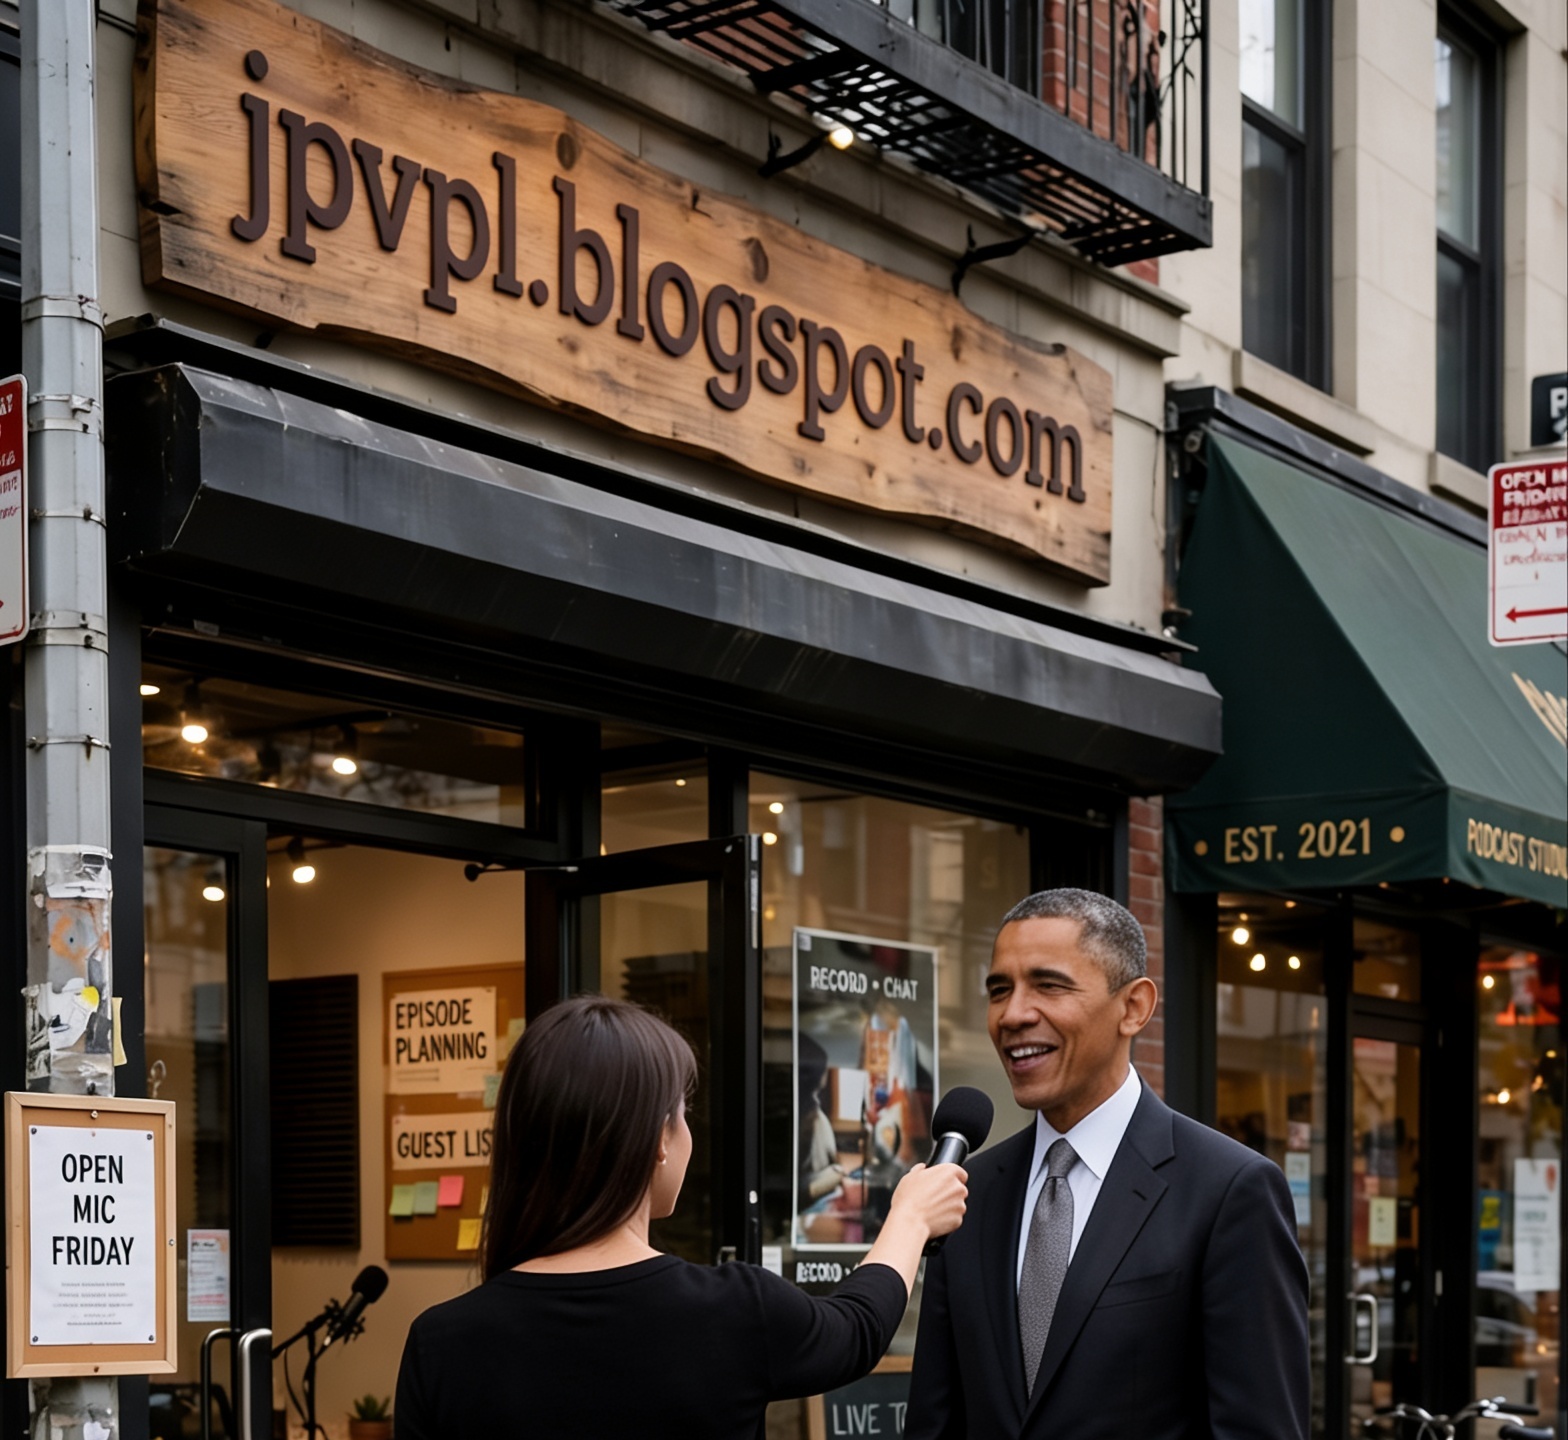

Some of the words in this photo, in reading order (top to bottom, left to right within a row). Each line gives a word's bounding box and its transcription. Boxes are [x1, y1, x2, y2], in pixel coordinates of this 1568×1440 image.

[230, 49, 1087, 503] jpvpl.blogspot.com
[1225, 825, 1285, 864] EST.
[1297, 817, 1371, 859] 2021
[1467, 817, 1526, 867] PODCAST
[810, 965, 868, 994] RECORD
[883, 976, 918, 1001] CHAT
[396, 998, 473, 1030] EPISODE
[396, 1031, 487, 1065] PLANNING
[397, 1130, 457, 1159] GUEST
[61, 1153, 124, 1184] OPEN
[73, 1194, 116, 1224] MIC
[52, 1236, 135, 1266] FRIDAY
[832, 1403, 881, 1435] LIVE
